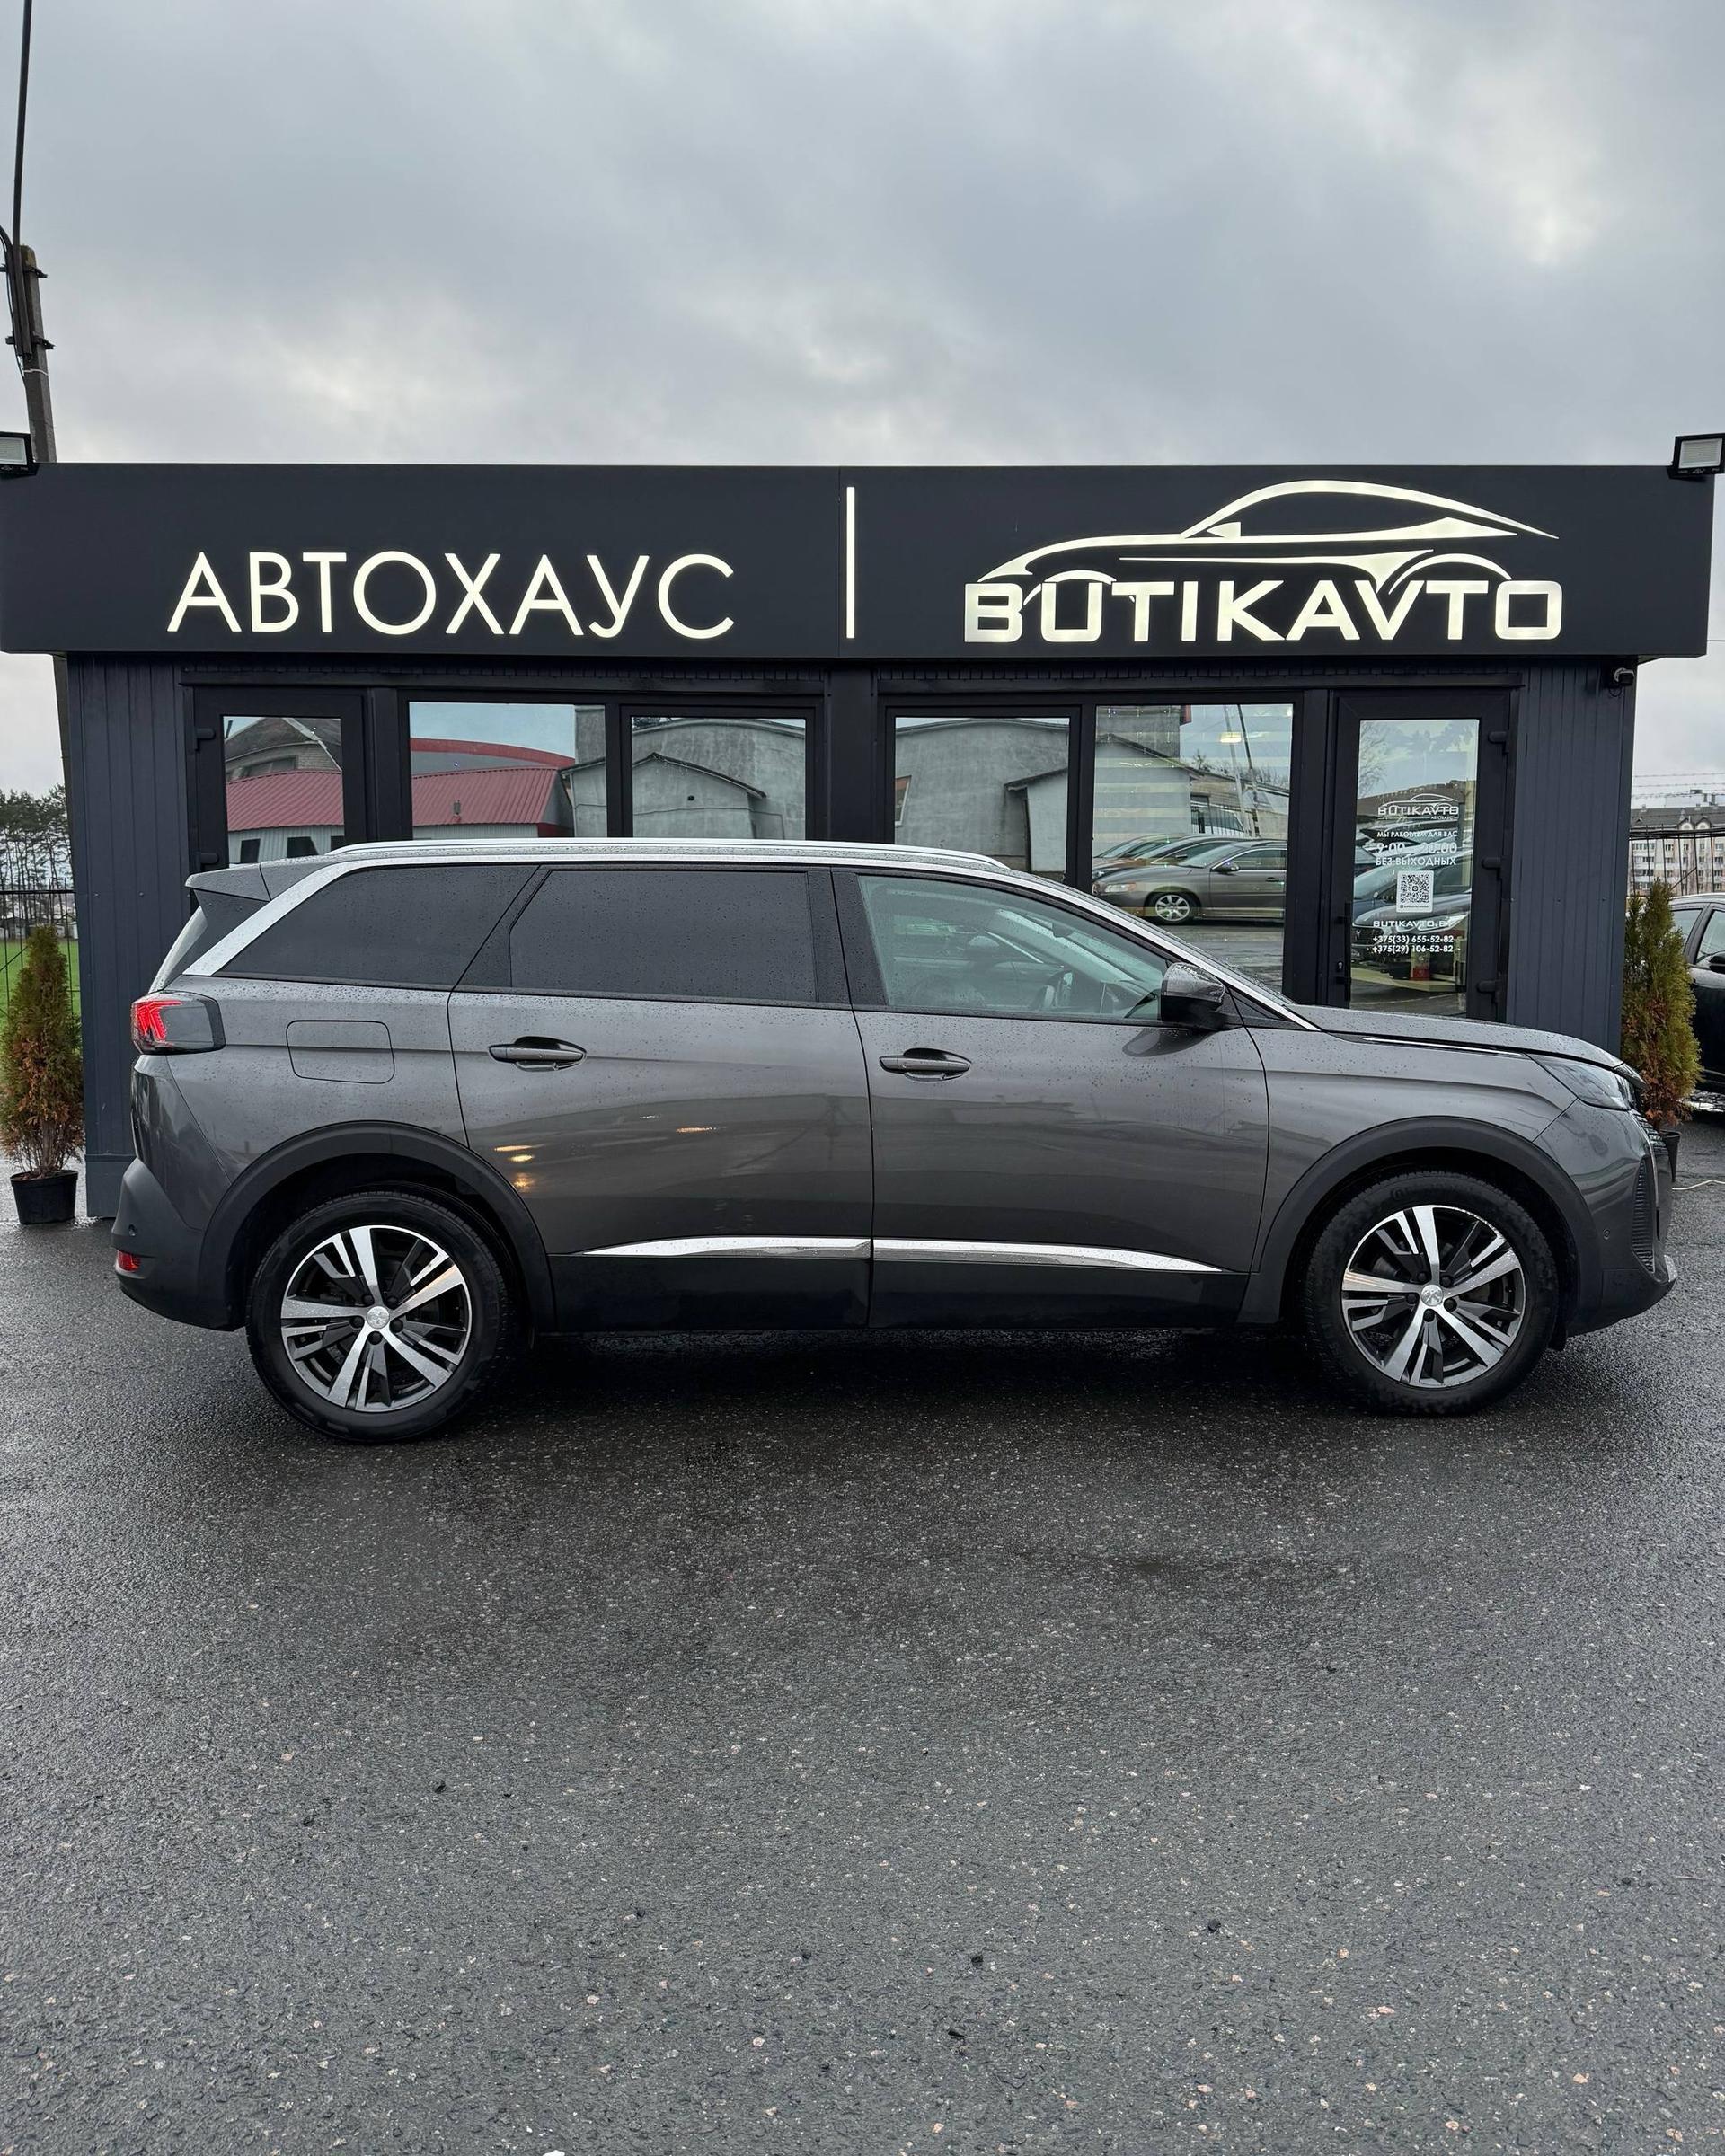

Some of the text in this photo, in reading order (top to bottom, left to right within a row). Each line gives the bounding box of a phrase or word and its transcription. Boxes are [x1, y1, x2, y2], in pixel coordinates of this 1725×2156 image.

[166, 550, 735, 640] АВТОХАУС
[964, 579, 1563, 643] BUTIKAVTO
[1377, 806, 1459, 816] BUTIKAVTO
[1376, 857, 1456, 866] БЕЗ ВЫХОДНЫХ
[1372, 935, 1454, 944] +375(33) 655-52-82
[1372, 945, 1454, 954] +375(29) 106-52-82
